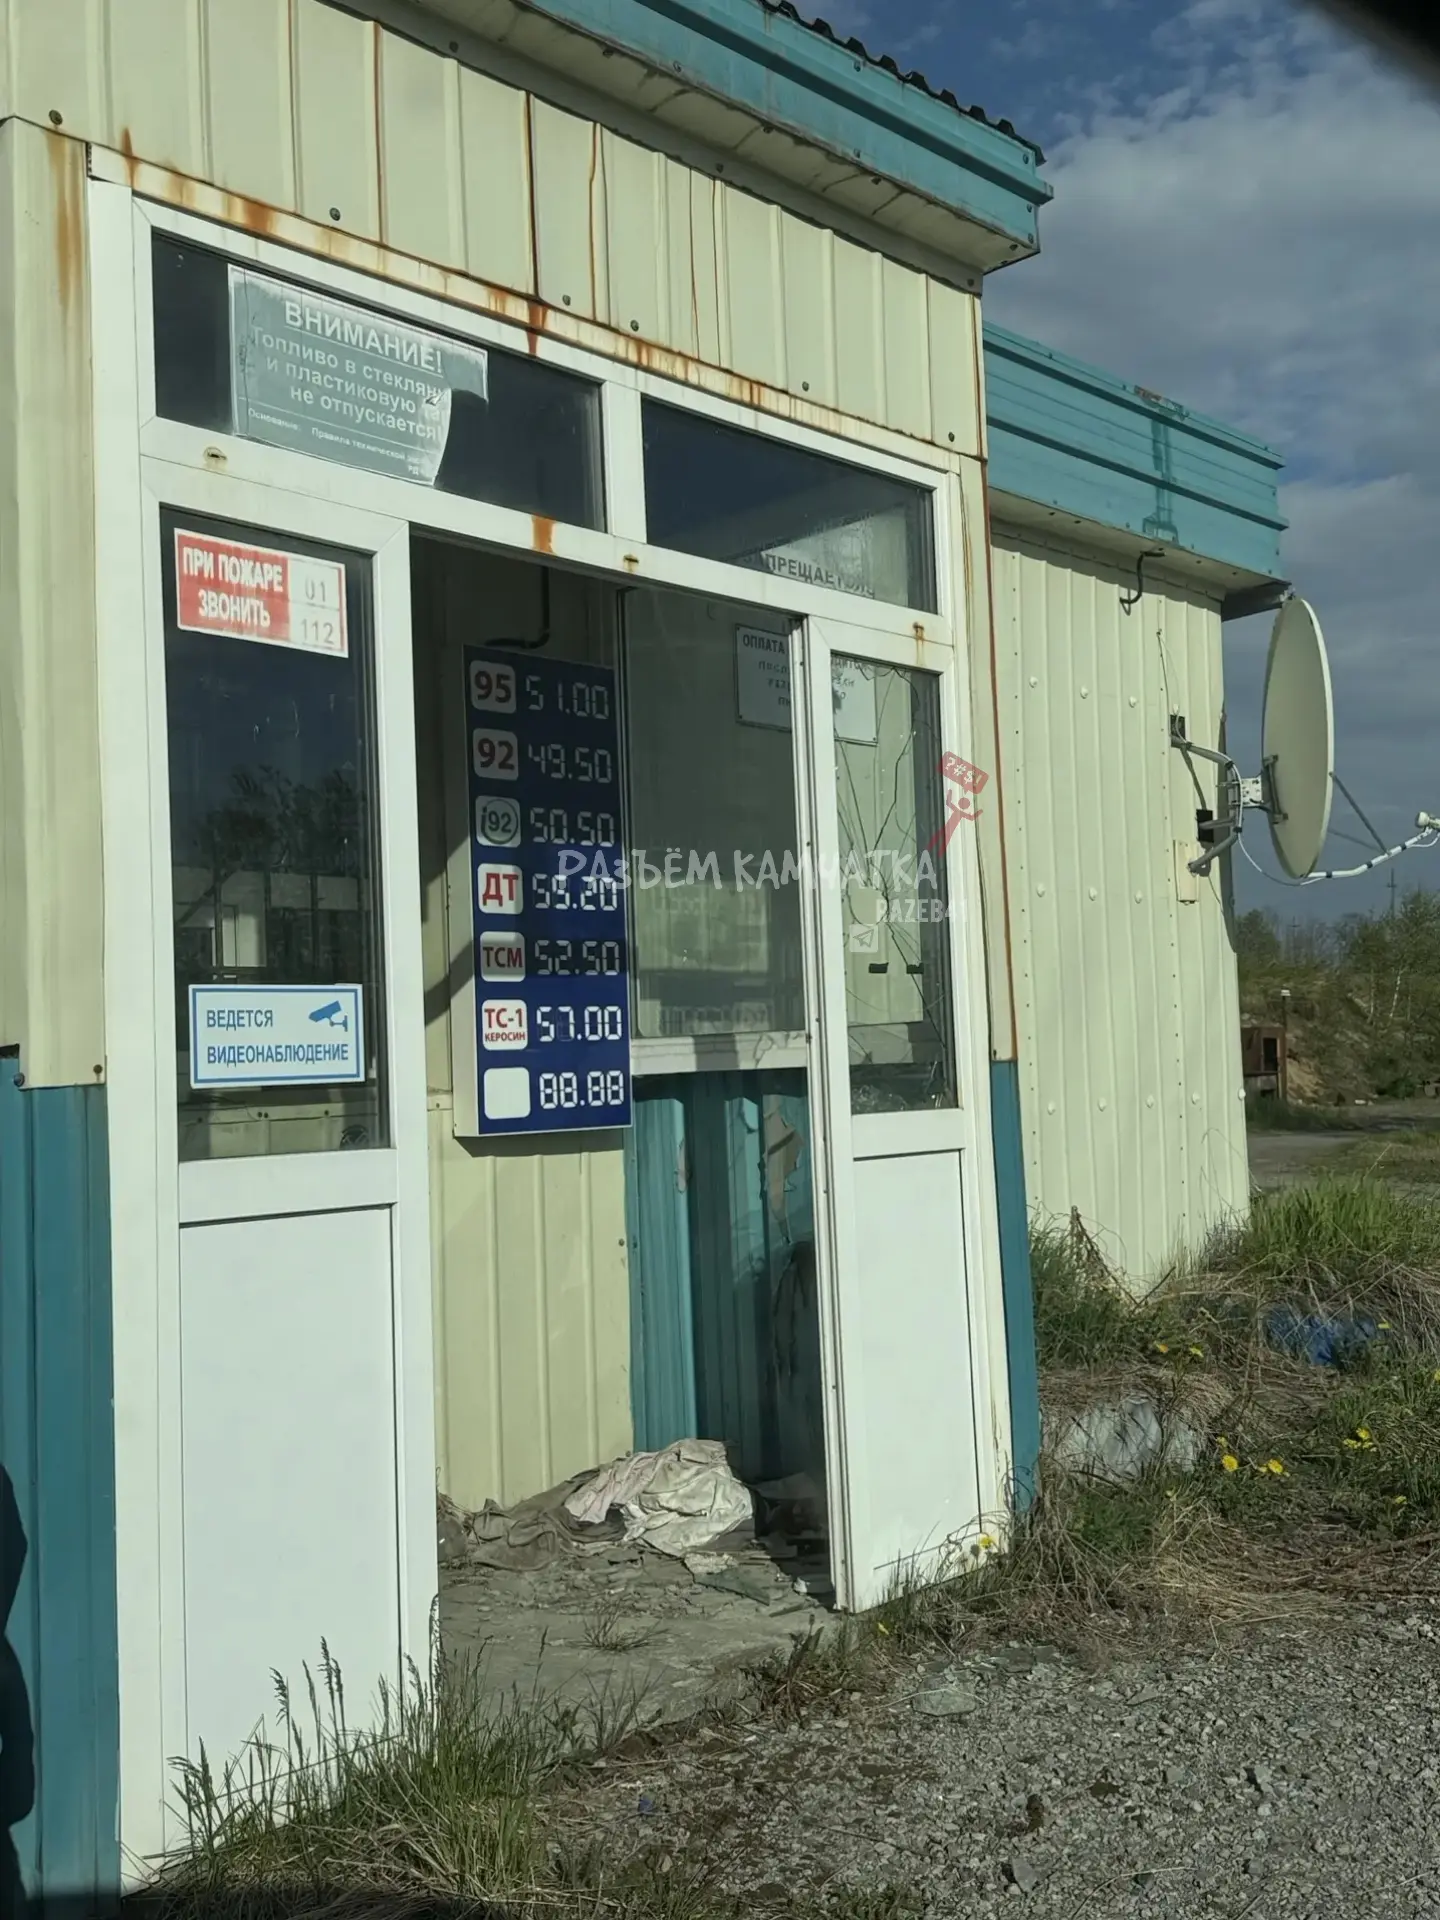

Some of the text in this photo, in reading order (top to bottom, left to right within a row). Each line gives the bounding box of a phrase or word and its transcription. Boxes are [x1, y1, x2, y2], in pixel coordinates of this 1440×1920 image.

[252, 327, 339, 369] Топливо
[345, 358, 357, 374] в
[284, 300, 443, 374] ВНИМАНИЕ!
[266, 357, 278, 373] и
[286, 363, 416, 415] пластиковую
[290, 387, 314, 405] не
[311, 426, 351, 447] Правила
[183, 546, 284, 592] ПРИ ПОЖАРЕ
[198, 589, 271, 628] ЗВОНИТЬ
[301, 618, 334, 644] 112
[474, 671, 609, 720] 95 51.00
[477, 738, 612, 784] 92 49.50
[530, 807, 615, 847] 50.50
[482, 872, 519, 907] ДТ
[483, 939, 620, 976] ТСМ 52.50
[206, 1009, 273, 1031] ВЕДЕТСЯ
[484, 1005, 622, 1042] ТС-1 57.00
[484, 1031, 526, 1042] КЕРОСИН
[207, 1043, 349, 1067] ВИДЕОНАБЛЮДЕНИЕ
[539, 1070, 624, 1110] 88.88
